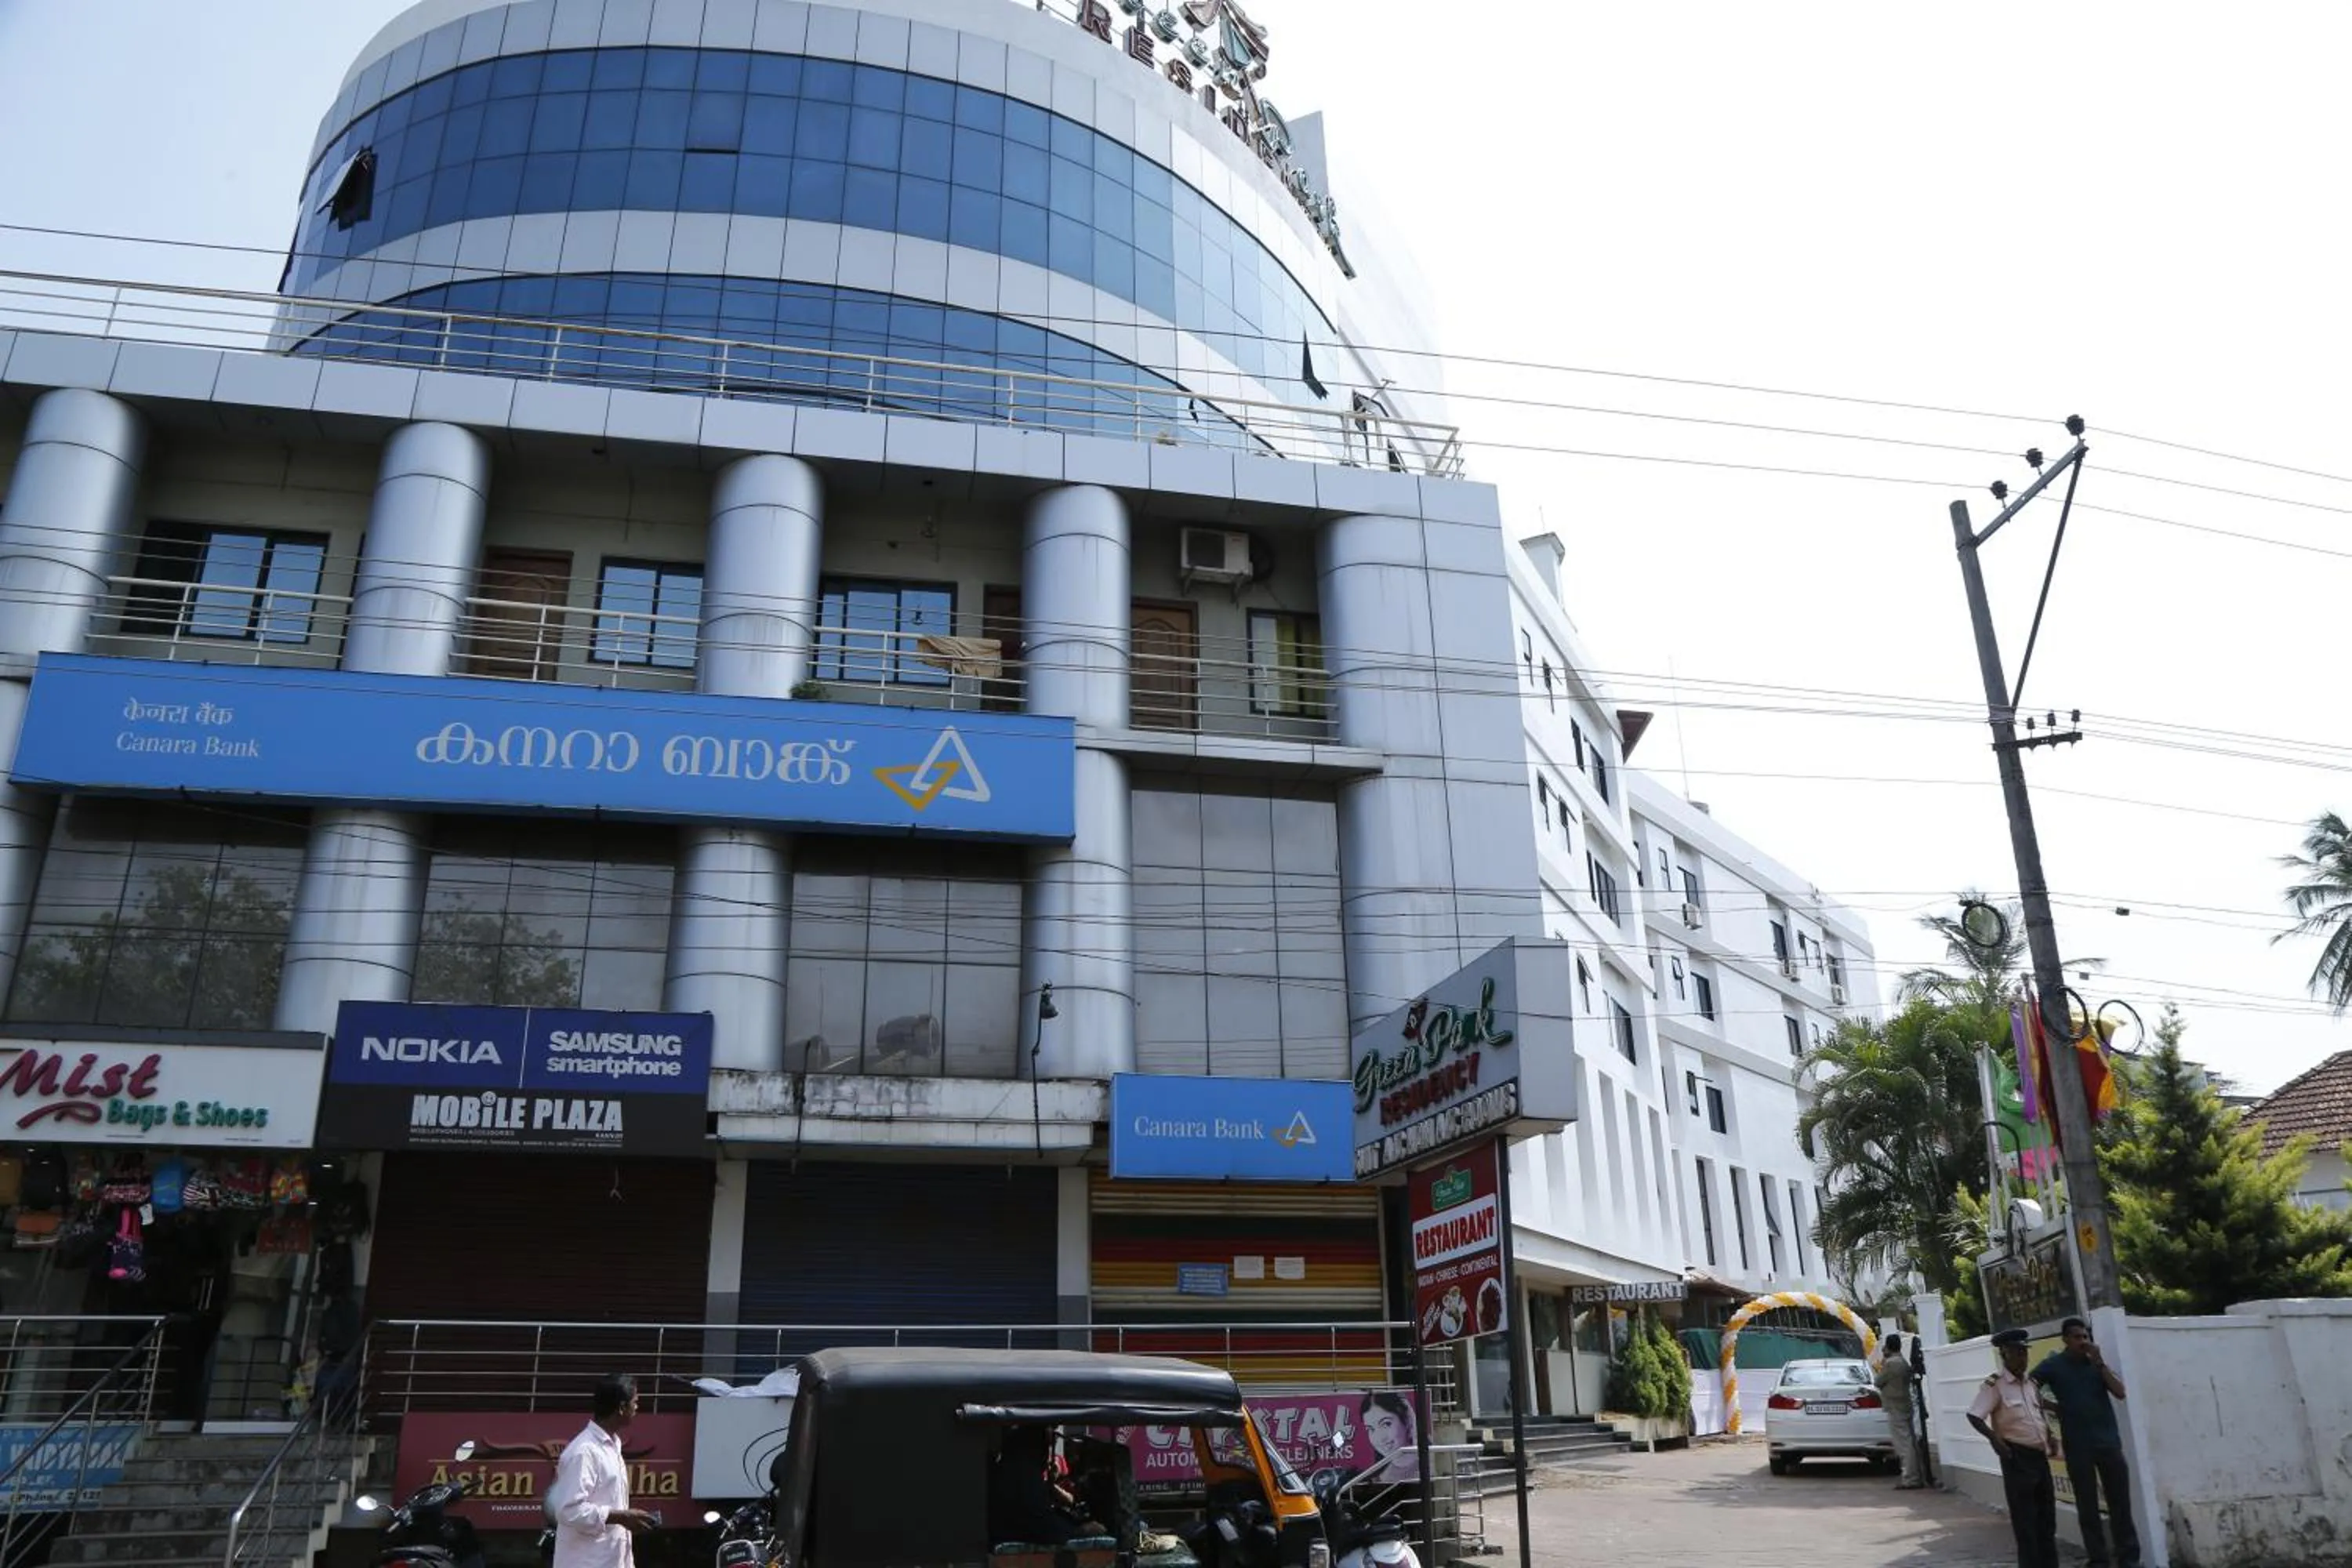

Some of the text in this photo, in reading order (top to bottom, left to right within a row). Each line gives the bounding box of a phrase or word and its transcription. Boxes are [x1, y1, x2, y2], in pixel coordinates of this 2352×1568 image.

[117, 731, 259, 758] Canara Bank
[416, 721, 639, 773] കനറാ
[361, 1037, 502, 1065] NOKIA
[549, 1031, 681, 1056] SAMSUNG
[0, 1049, 162, 1098] Mist
[546, 1056, 681, 1079] smartphone
[1354, 1048, 1421, 1114] Green
[107, 1098, 269, 1131] Bags & Shoes
[532, 1098, 622, 1131] PLAZA
[1134, 1116, 1265, 1139] Canara Bank
[1415, 1206, 1494, 1260] RESTAURANT
[1572, 1281, 1684, 1304] RESTAURANT
[430, 1465, 535, 1497] Asian
